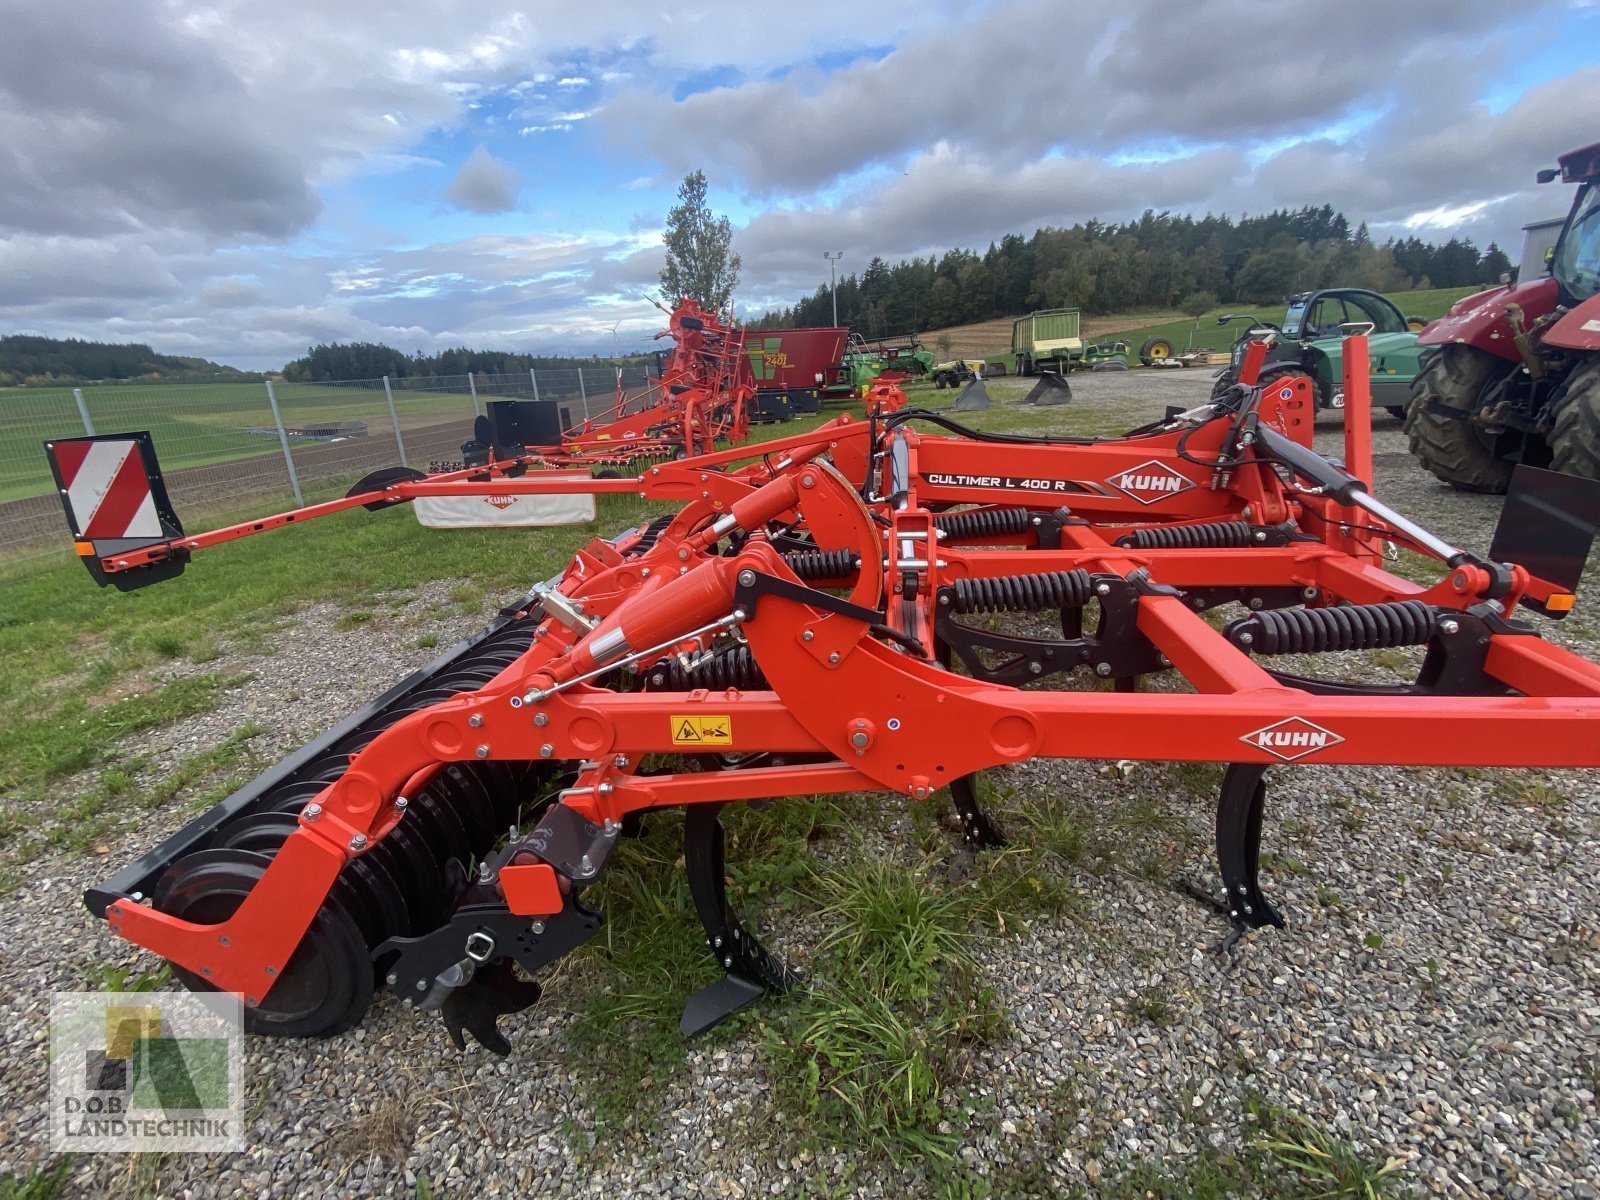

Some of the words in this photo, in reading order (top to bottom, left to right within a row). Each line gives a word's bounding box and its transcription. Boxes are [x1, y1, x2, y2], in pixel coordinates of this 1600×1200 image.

[928, 474, 1000, 487] CULTIMER
[1006, 478, 1015, 488] L
[1020, 480, 1050, 490] 400
[1054, 481, 1066, 491] R
[1120, 474, 1182, 491] KUHN
[487, 496, 515, 504] KUHN
[1258, 732, 1327, 746] KUHN
